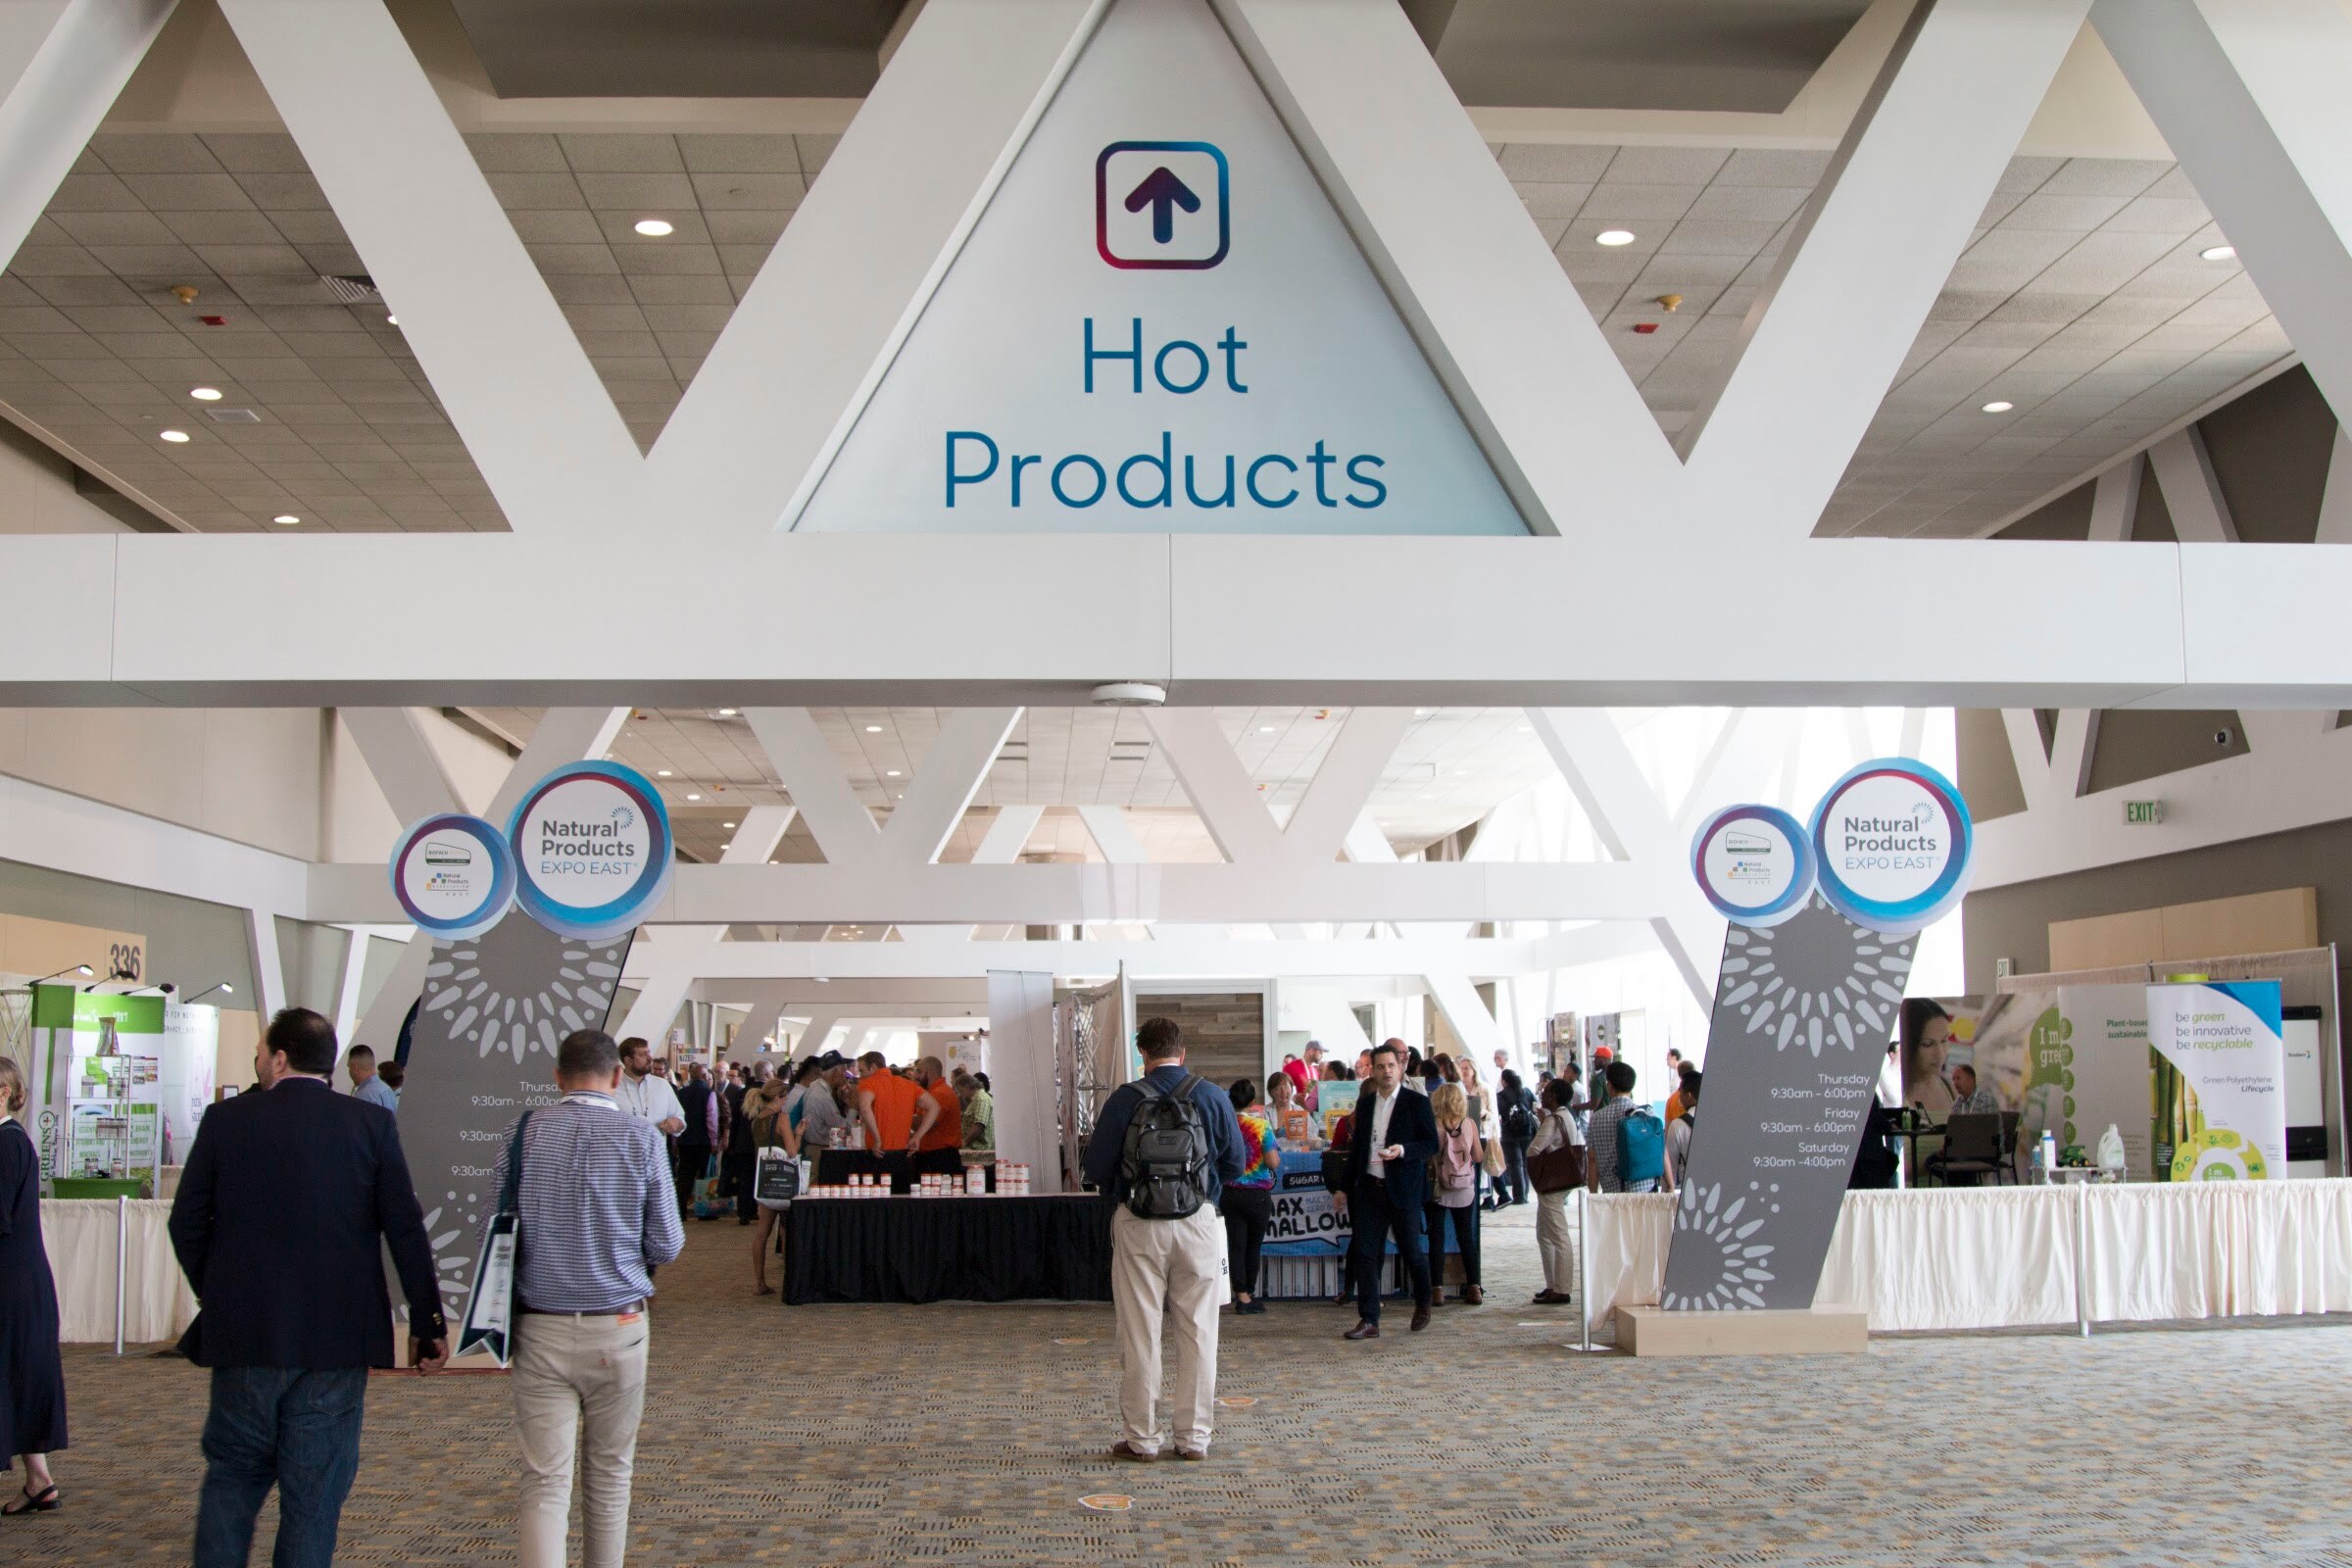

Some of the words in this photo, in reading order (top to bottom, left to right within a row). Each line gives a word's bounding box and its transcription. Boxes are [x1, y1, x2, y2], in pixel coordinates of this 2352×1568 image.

[1083, 317, 1250, 394] Hot
[945, 430, 1389, 509] Products
[2128, 802, 2153, 822] EXIT
[542, 820, 618, 837] Natural
[1844, 816, 1919, 832] Natural
[541, 839, 635, 858] Products
[1844, 835, 1936, 852] Products
[541, 861, 586, 874] EXPO
[590, 861, 630, 875] EAST
[1845, 857, 1889, 870] EXPO
[1893, 857, 1935, 869] EAST
[110, 944, 141, 982] 336
[2176, 1012, 2190, 1023] be
[2192, 1012, 2226, 1024] green
[2176, 1026, 2190, 1037] be
[2192, 1025, 2252, 1036] innovative
[2176, 1040, 2191, 1050] be
[2193, 1038, 2254, 1052] recyclable
[1818, 1073, 1871, 1087] Thursday
[2226, 1076, 2273, 1085] Polyethylene
[1771, 1088, 1813, 1099] 9:30am
[1824, 1087, 1866, 1100] 6:00pm
[2241, 1085, 2275, 1094] Lifecycle
[471, 1095, 514, 1106] 9:30am
[1825, 1107, 1860, 1120] Friday
[1760, 1122, 1803, 1133] 9:30am
[1814, 1121, 1856, 1134] 6:00pm
[460, 1130, 503, 1141] 9:30am
[1798, 1142, 1850, 1154] Saturday
[1753, 1156, 1795, 1167] 9:30am
[451, 1165, 494, 1176] 9:30am
[1289, 1175, 1319, 1186] SUGAR
